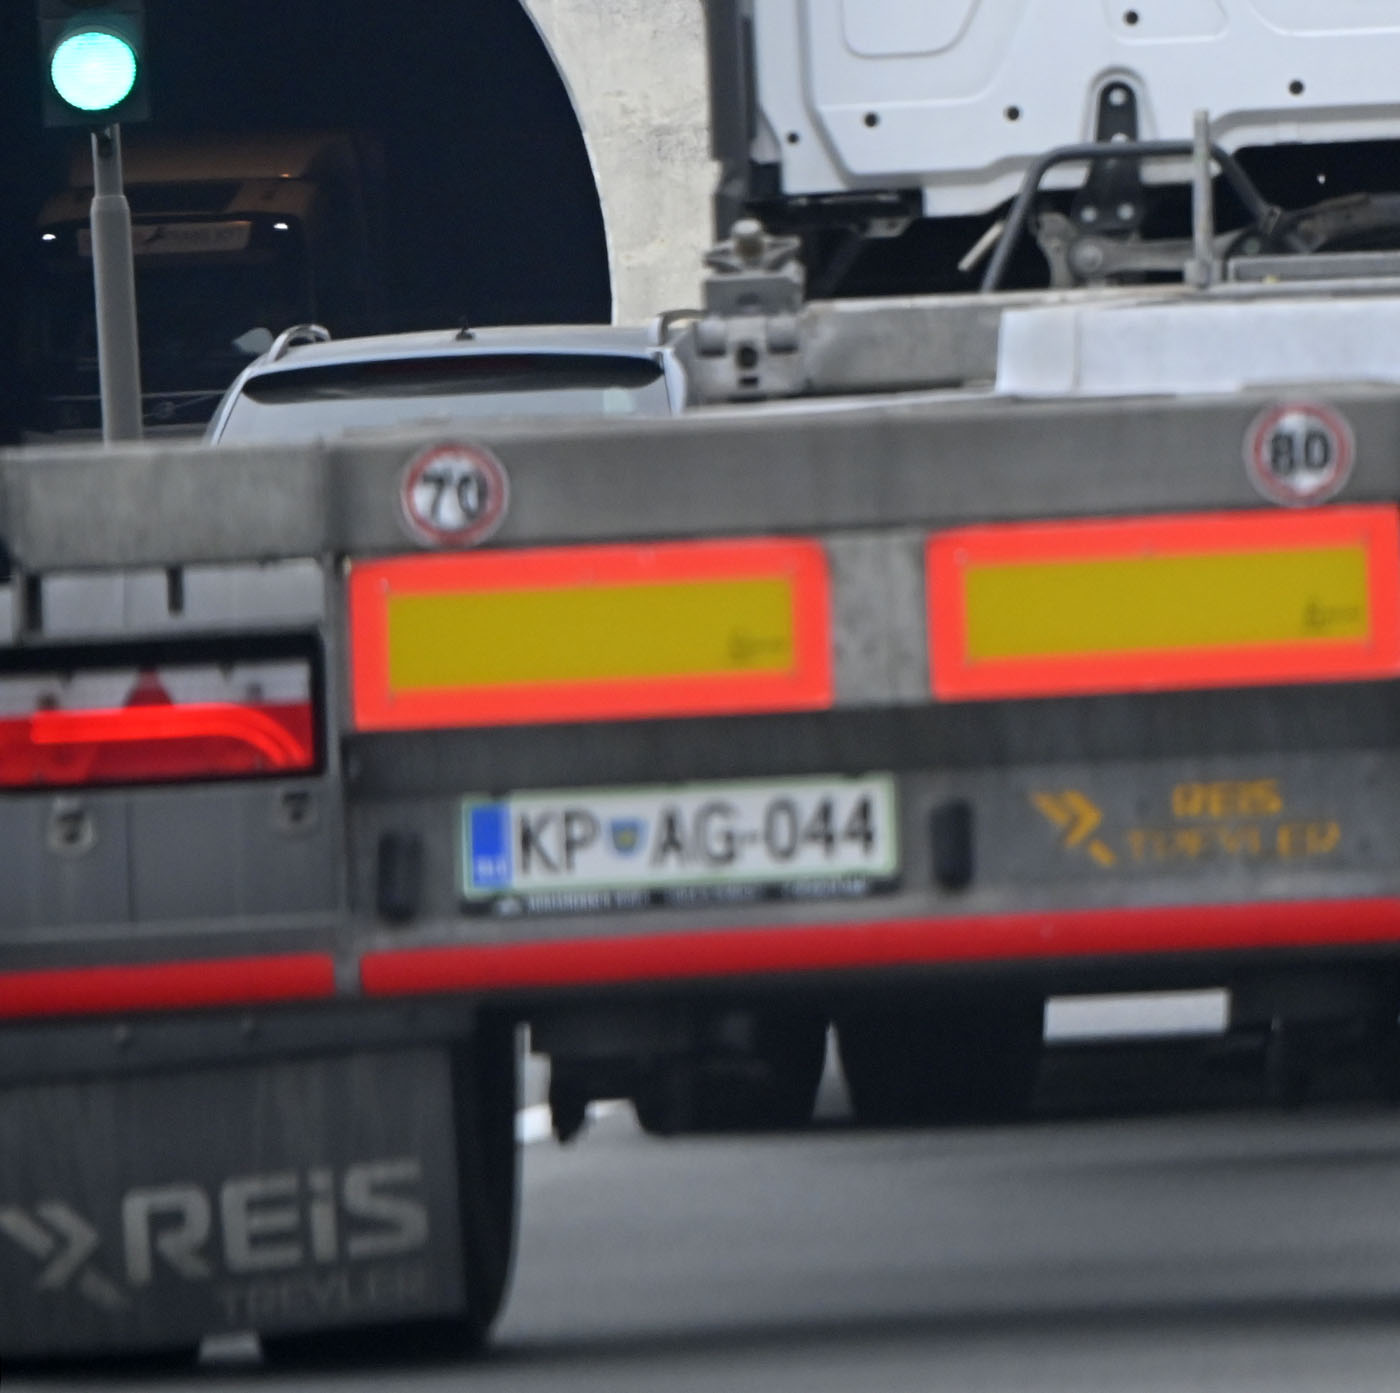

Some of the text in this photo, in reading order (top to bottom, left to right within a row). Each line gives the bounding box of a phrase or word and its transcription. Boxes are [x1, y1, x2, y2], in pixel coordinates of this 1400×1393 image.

[1270, 428, 1330, 476] 80
[421, 467, 488, 521] 70
[517, 791, 876, 876] KP AG-044
